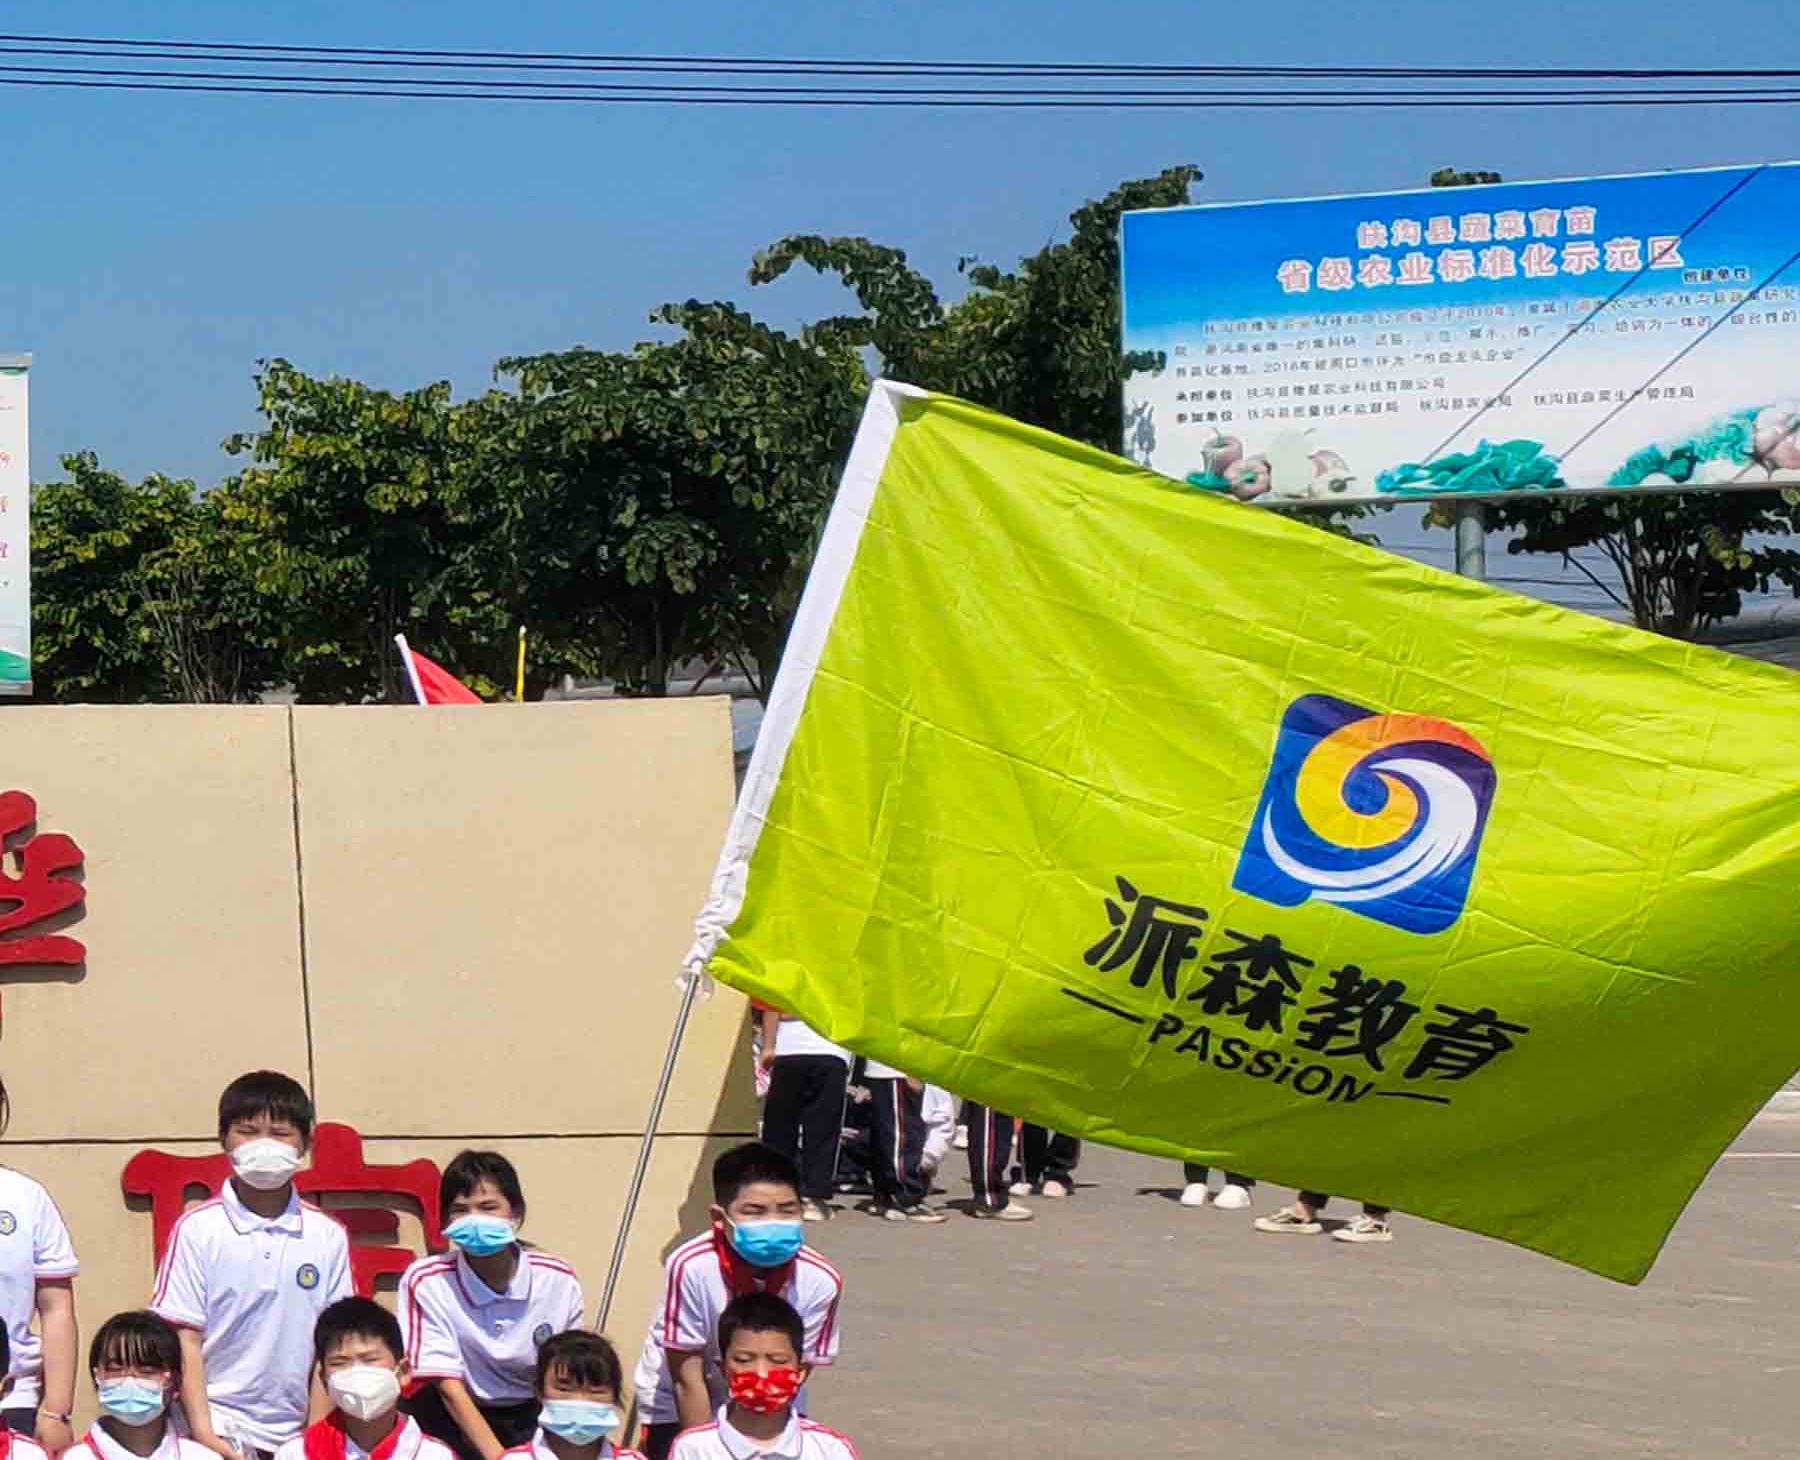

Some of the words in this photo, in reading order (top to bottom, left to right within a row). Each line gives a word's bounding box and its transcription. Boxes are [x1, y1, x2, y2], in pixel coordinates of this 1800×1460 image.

[1277, 236, 1685, 292] 省级农业标准化示范区
[1083, 875, 1530, 1081] 派森教育
